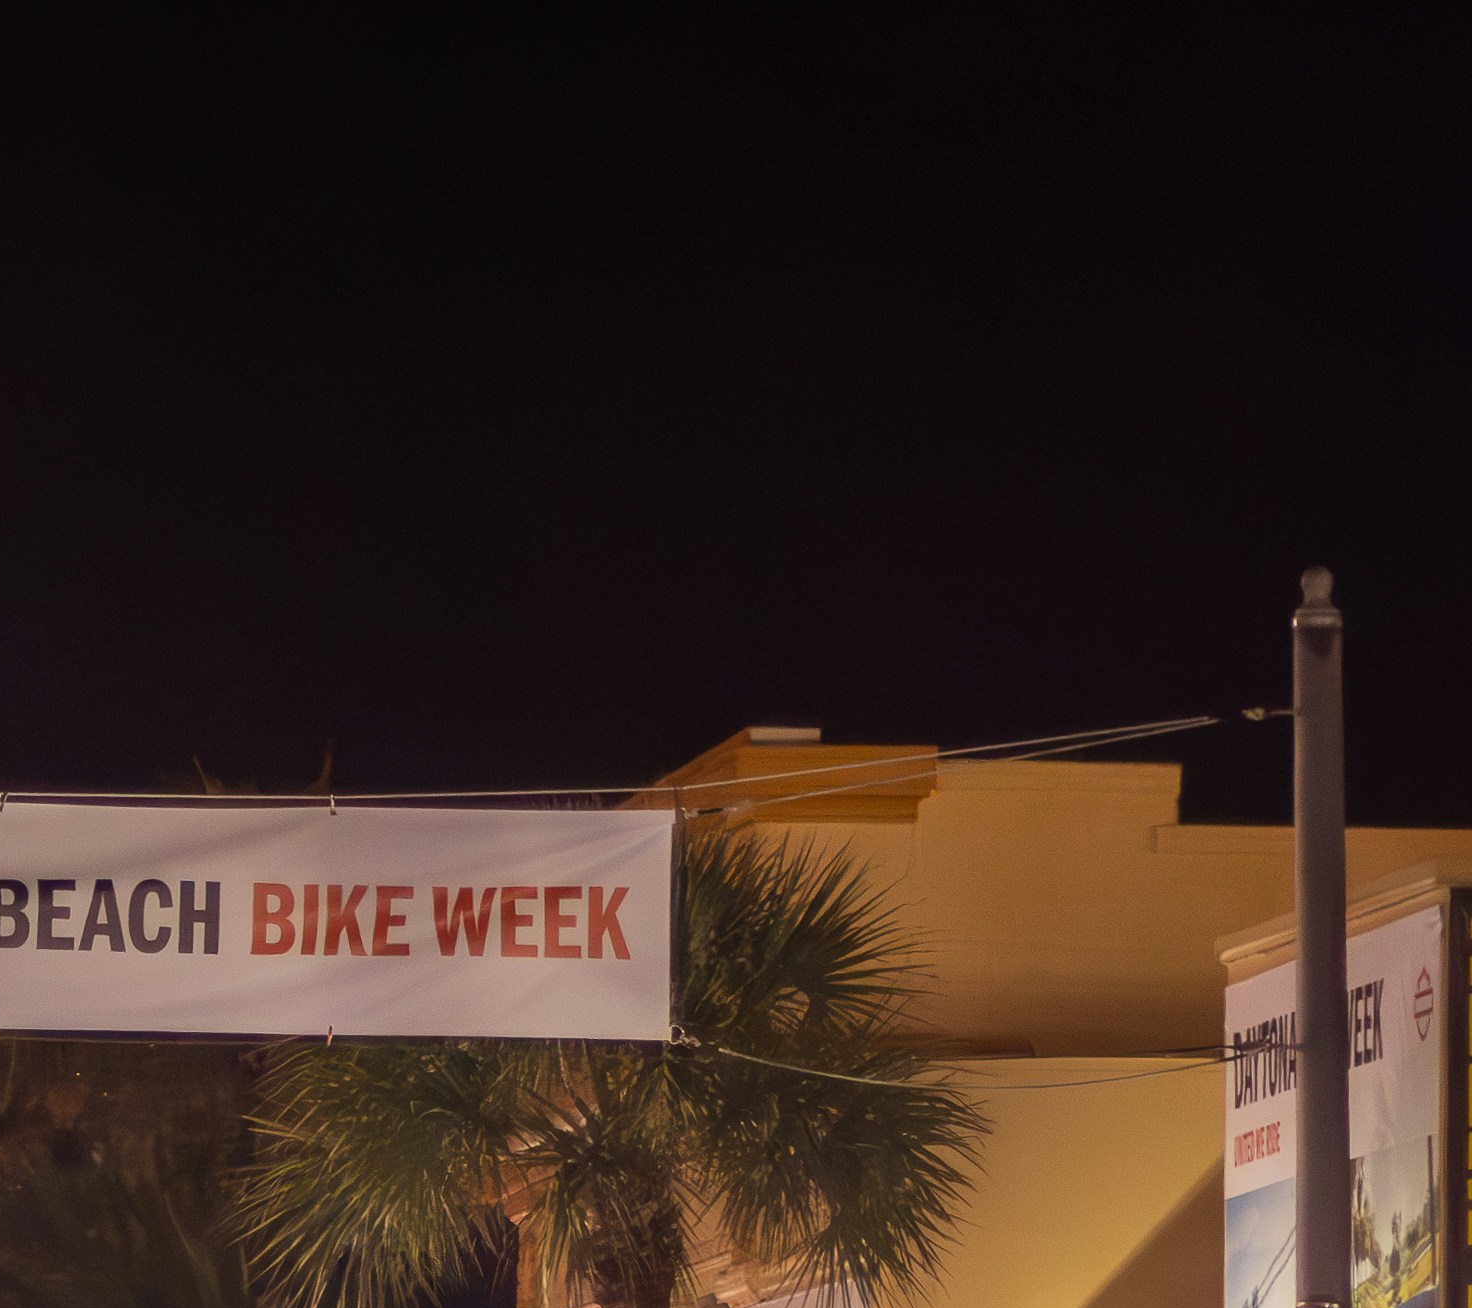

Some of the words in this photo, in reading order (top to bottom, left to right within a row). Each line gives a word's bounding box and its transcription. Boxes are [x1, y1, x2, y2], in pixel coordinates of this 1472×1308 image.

[251, 882, 414, 957] BIKE
[432, 886, 632, 960] WEEK
[1233, 1011, 1296, 1109] DAYTONA
[1348, 978, 1385, 1068] EEK
